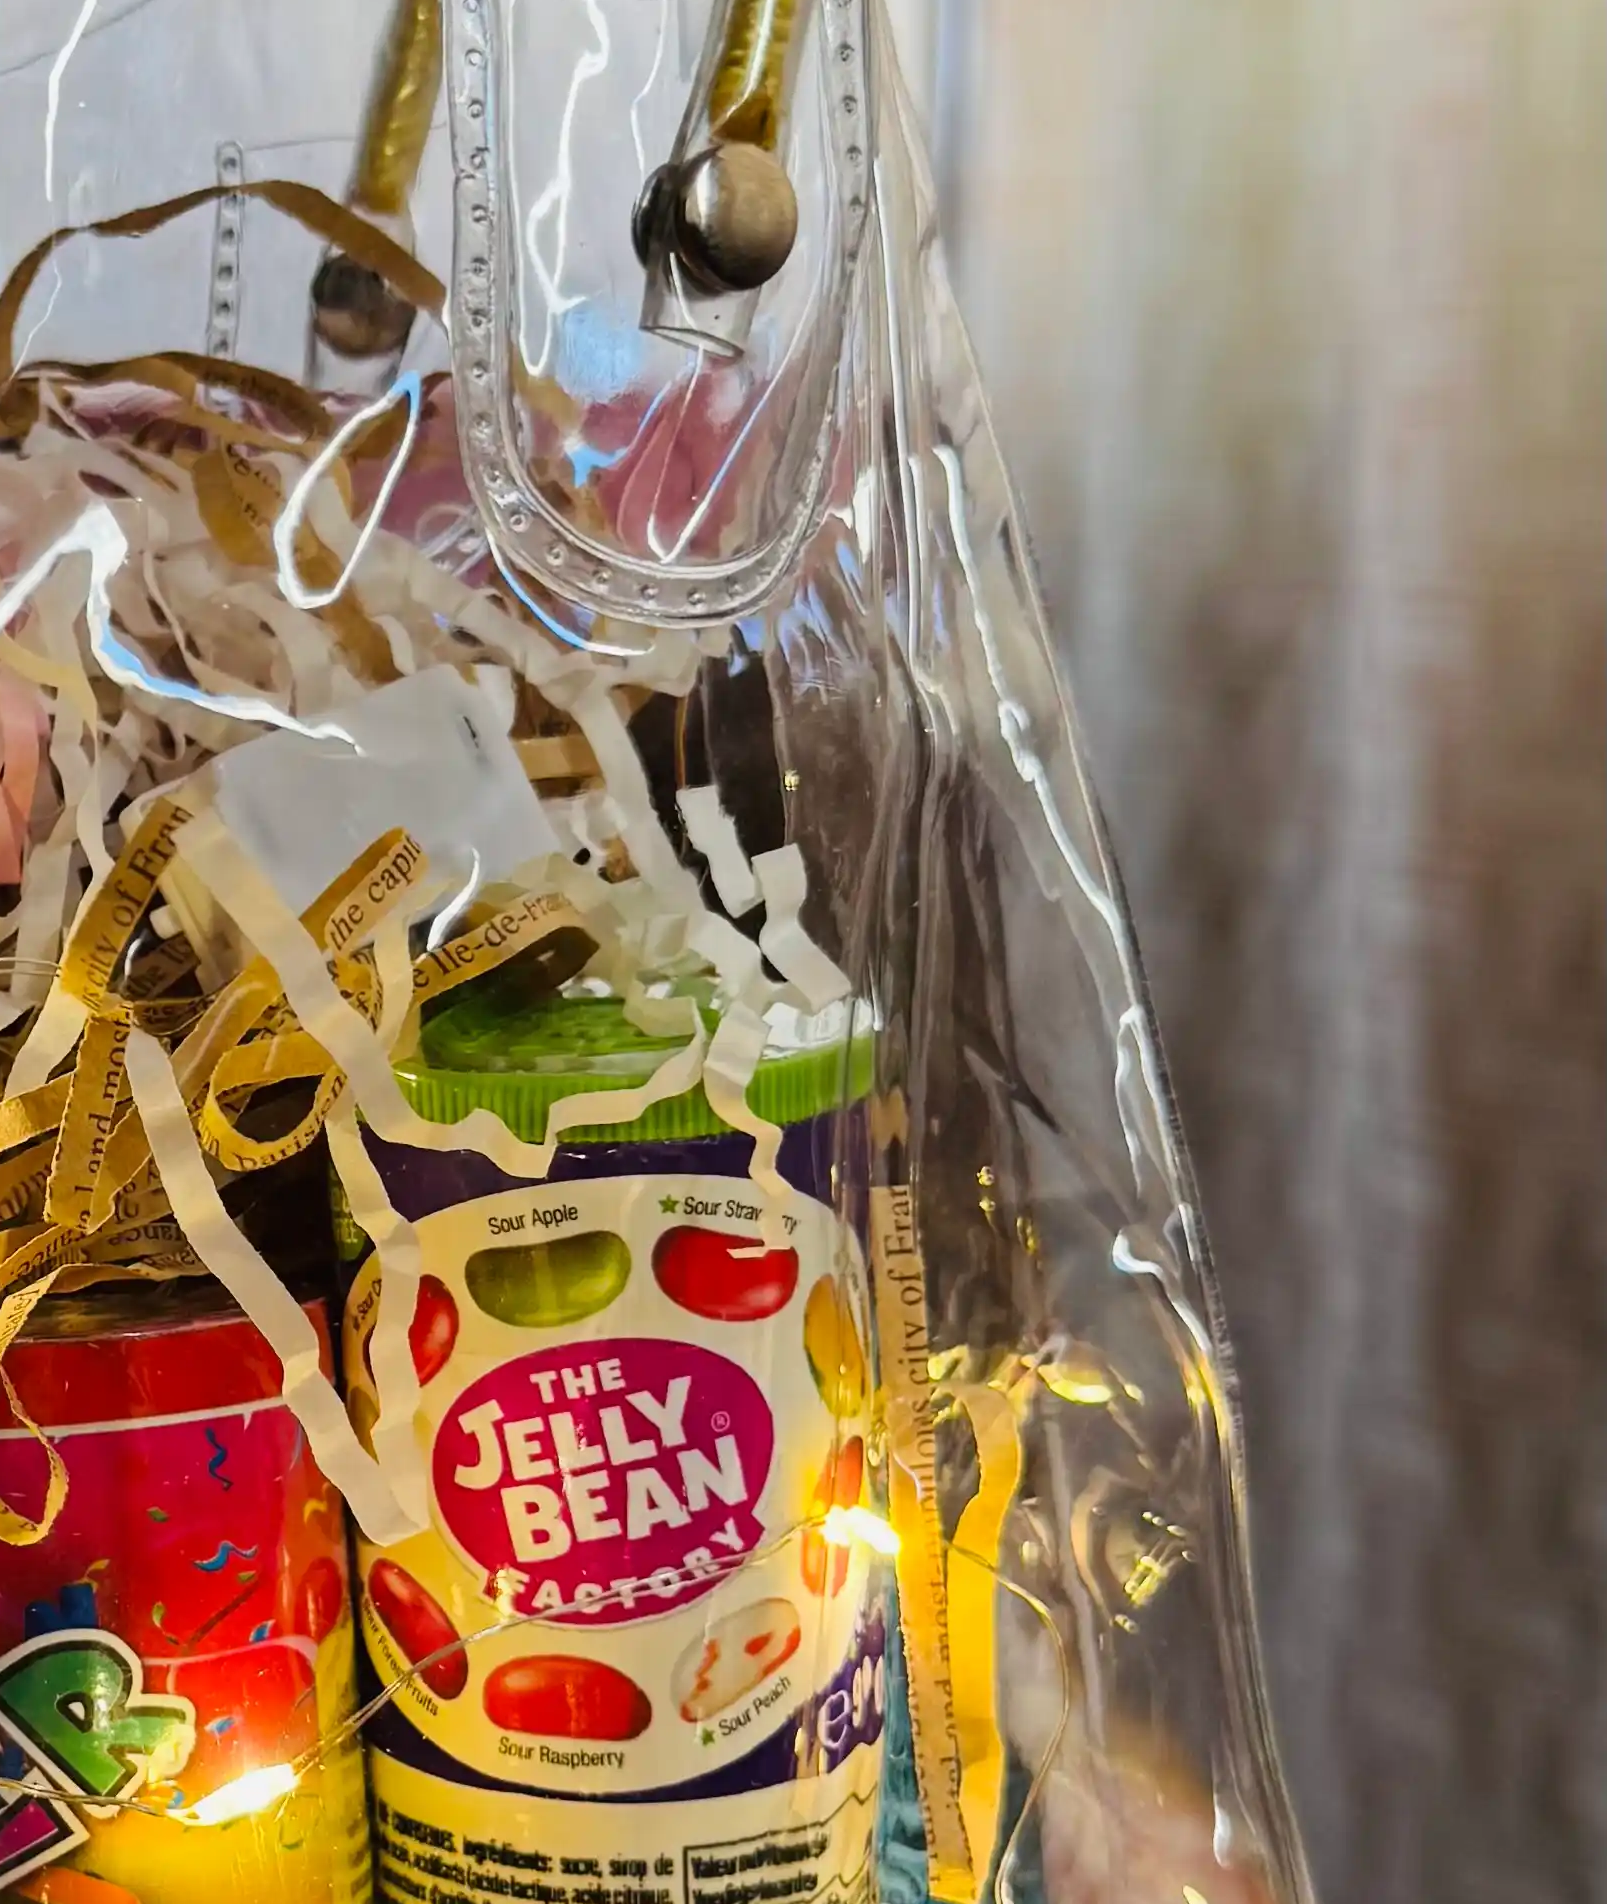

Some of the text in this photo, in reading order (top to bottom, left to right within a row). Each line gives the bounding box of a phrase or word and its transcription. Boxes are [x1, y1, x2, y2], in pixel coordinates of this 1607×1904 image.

[112, 878, 145, 929] of
[328, 909, 365, 953] the
[86, 1112, 112, 1174] and
[488, 1203, 580, 1236] Sour Apple
[683, 1196, 721, 1217] Sour
[888, 1265, 924, 1307] of
[528, 1357, 627, 1405] THE
[453, 1375, 693, 1491] JELLY
[499, 1433, 749, 1565] BEAN
[497, 1516, 746, 1614] FACTORY
[717, 1675, 792, 1738] Sour Peach
[498, 1736, 625, 1770] Sour Raspberry
[653, 1852, 674, 1876] de
